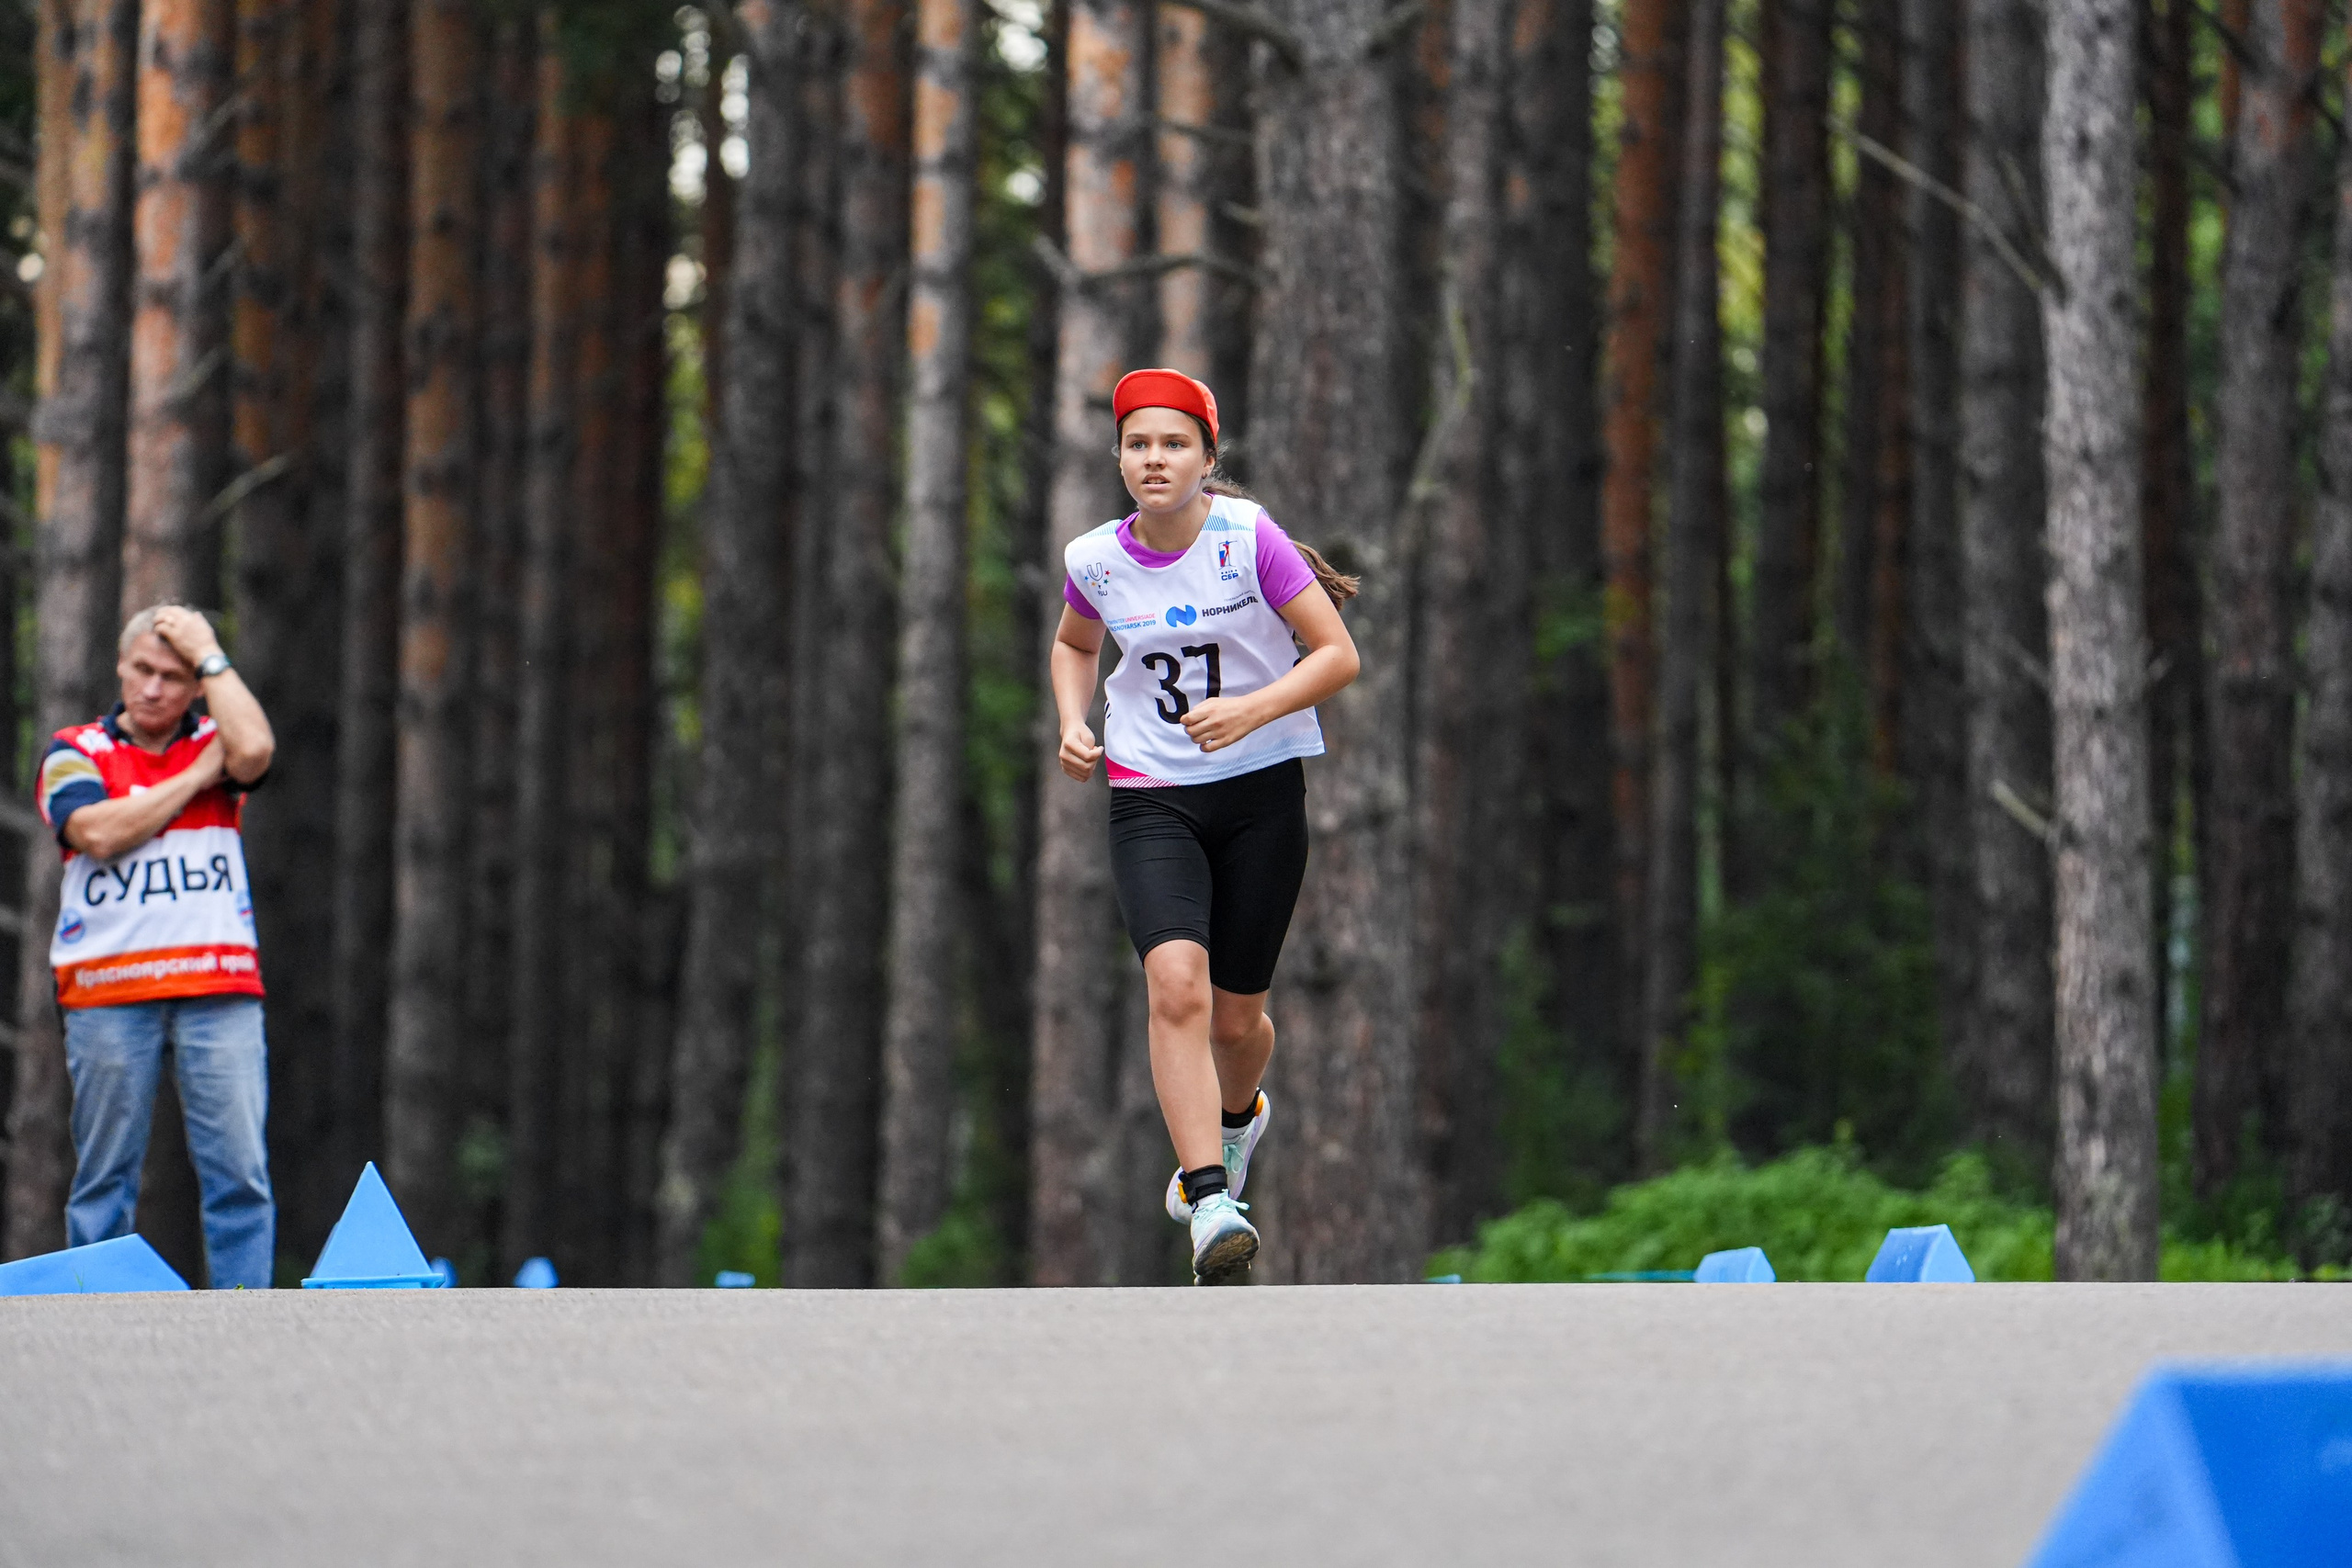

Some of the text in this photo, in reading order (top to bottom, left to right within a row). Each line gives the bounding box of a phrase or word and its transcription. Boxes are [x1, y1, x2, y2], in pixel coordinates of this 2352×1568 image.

[1221, 572, 1239, 581] СБР
[1202, 595, 1259, 616] НОРНИКЕЛЬ
[1141, 642, 1222, 725] 37
[84, 854, 233, 907] СУДЬЯ
